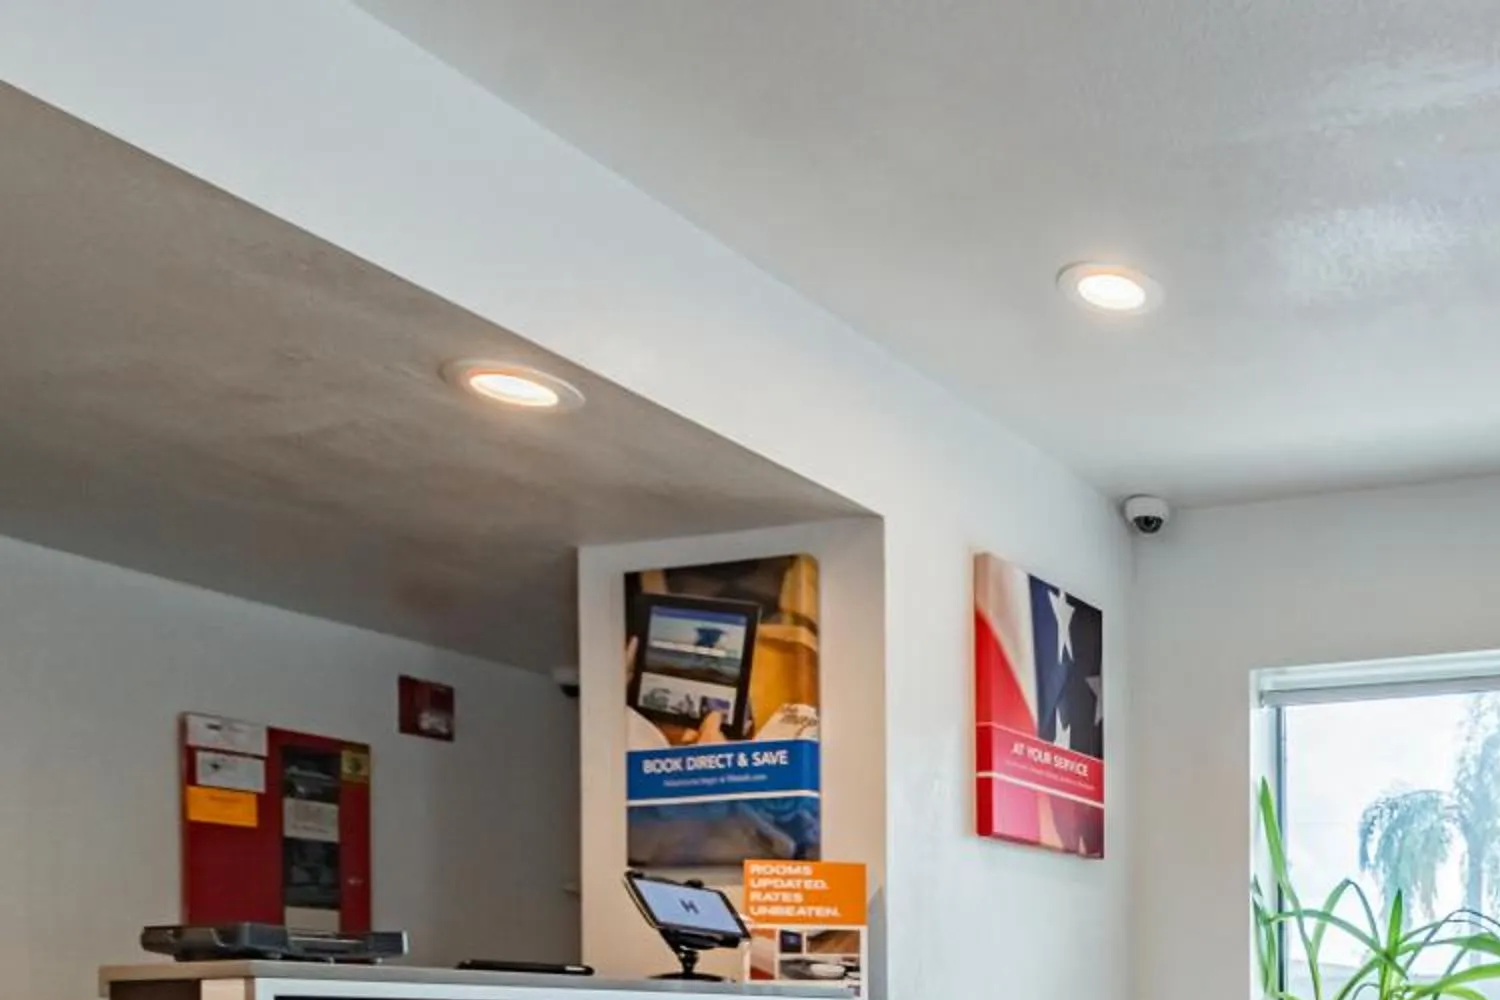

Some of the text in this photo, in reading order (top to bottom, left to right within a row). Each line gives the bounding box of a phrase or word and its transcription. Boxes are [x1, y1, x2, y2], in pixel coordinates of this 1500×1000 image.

[643, 750, 789, 774] BOOK DIRECT & SAVE
[1012, 743, 1025, 755] AT
[1026, 746, 1052, 765] YOUR
[1053, 754, 1088, 776] SERVICE
[750, 864, 814, 876] ROOMS
[750, 892, 804, 904] RATES
